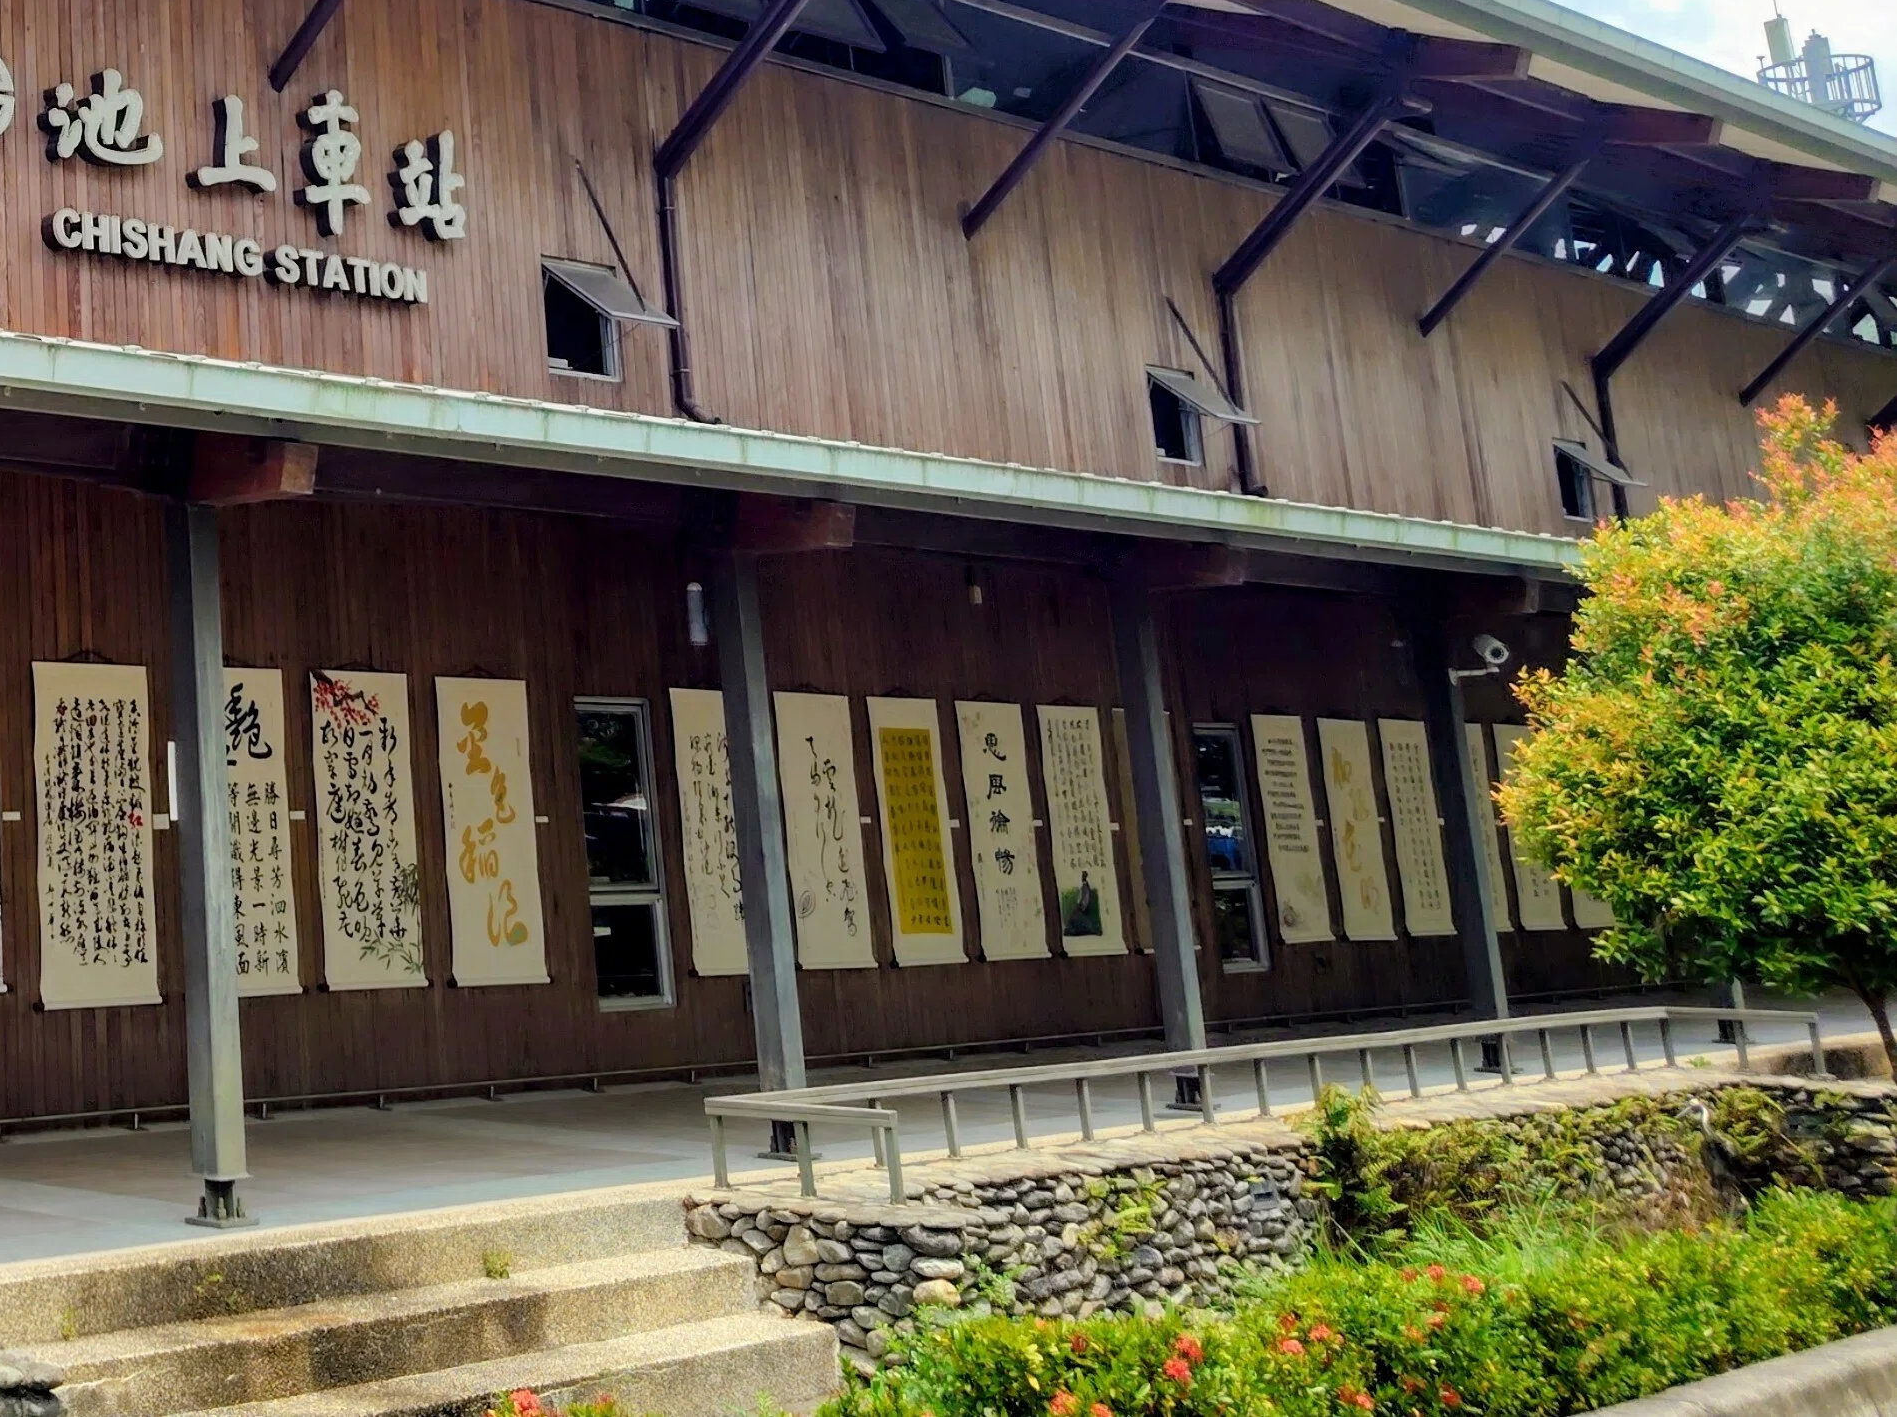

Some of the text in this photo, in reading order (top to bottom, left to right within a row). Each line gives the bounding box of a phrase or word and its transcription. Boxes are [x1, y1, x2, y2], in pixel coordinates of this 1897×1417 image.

[39, 68, 467, 242] 池上車站
[44, 206, 428, 305] CHISHANG STATION
